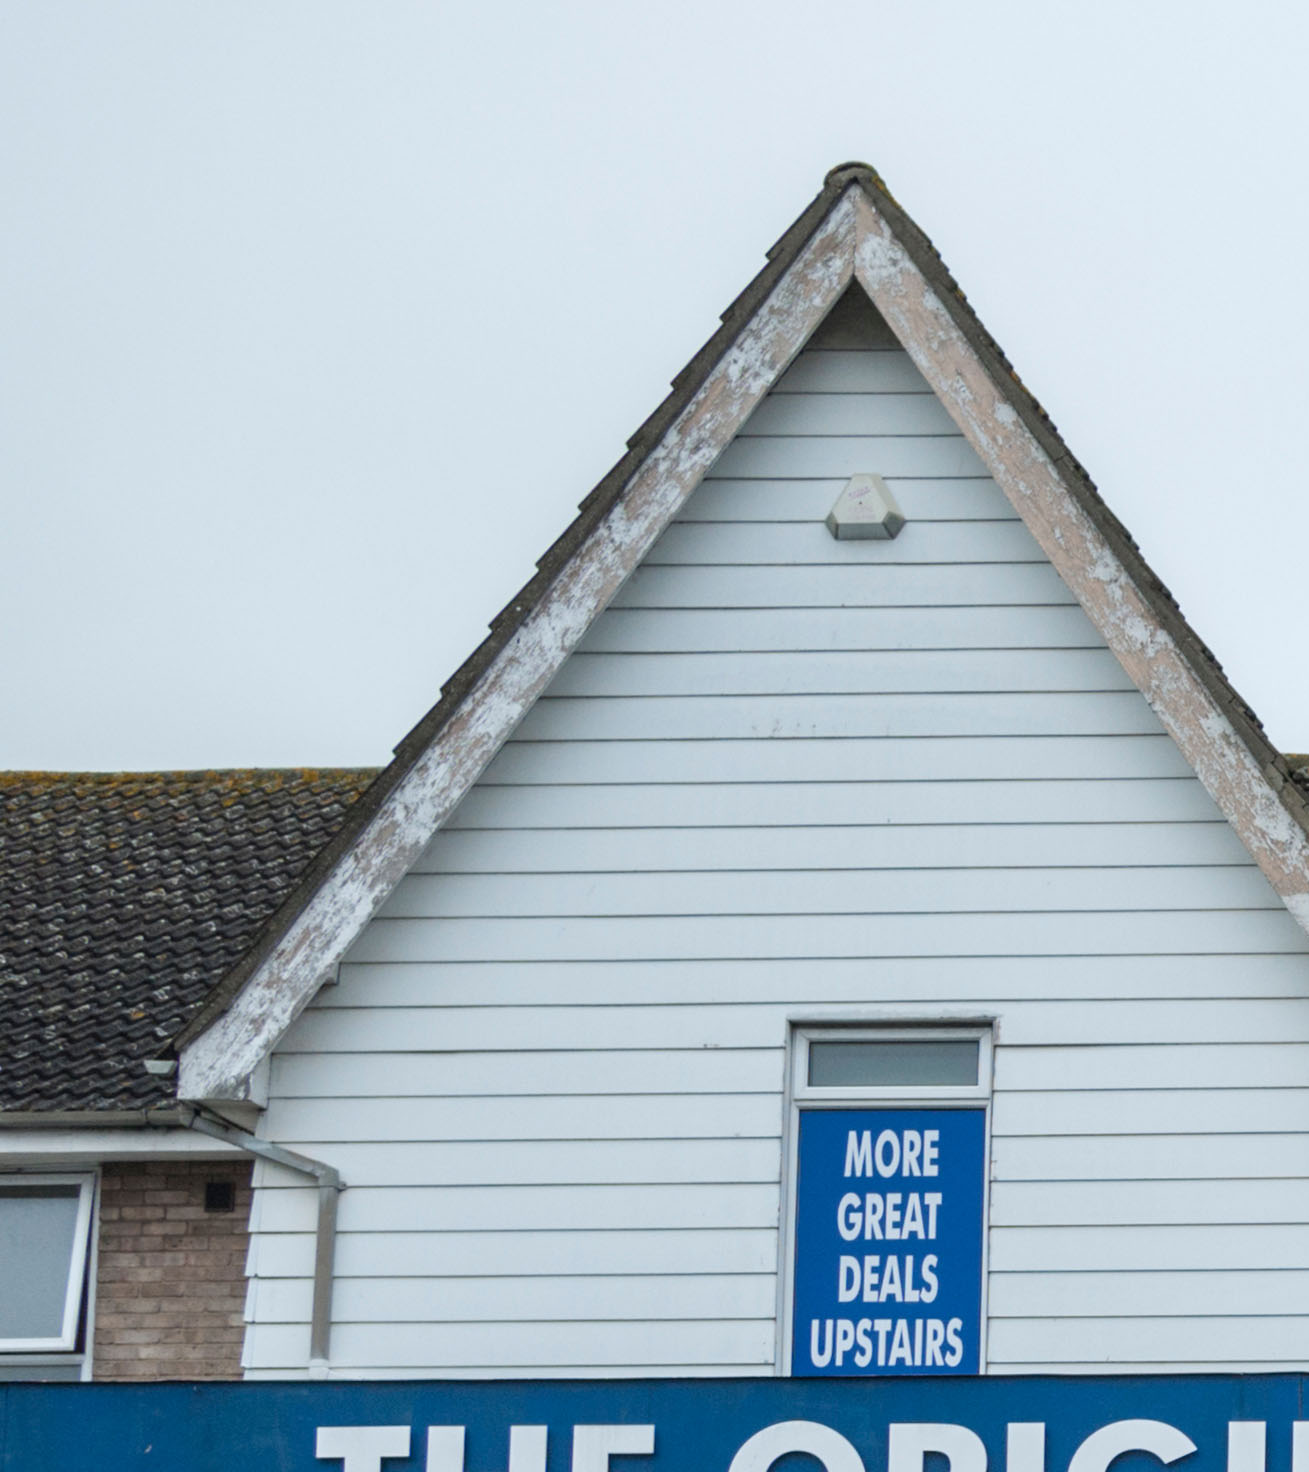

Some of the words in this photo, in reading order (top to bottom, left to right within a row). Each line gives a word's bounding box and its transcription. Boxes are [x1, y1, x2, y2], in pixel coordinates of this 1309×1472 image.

[843, 1129, 940, 1179] MORE
[837, 1191, 942, 1241] GREAT
[838, 1254, 939, 1304] DEALS
[810, 1317, 964, 1368] UPSTAIRS
